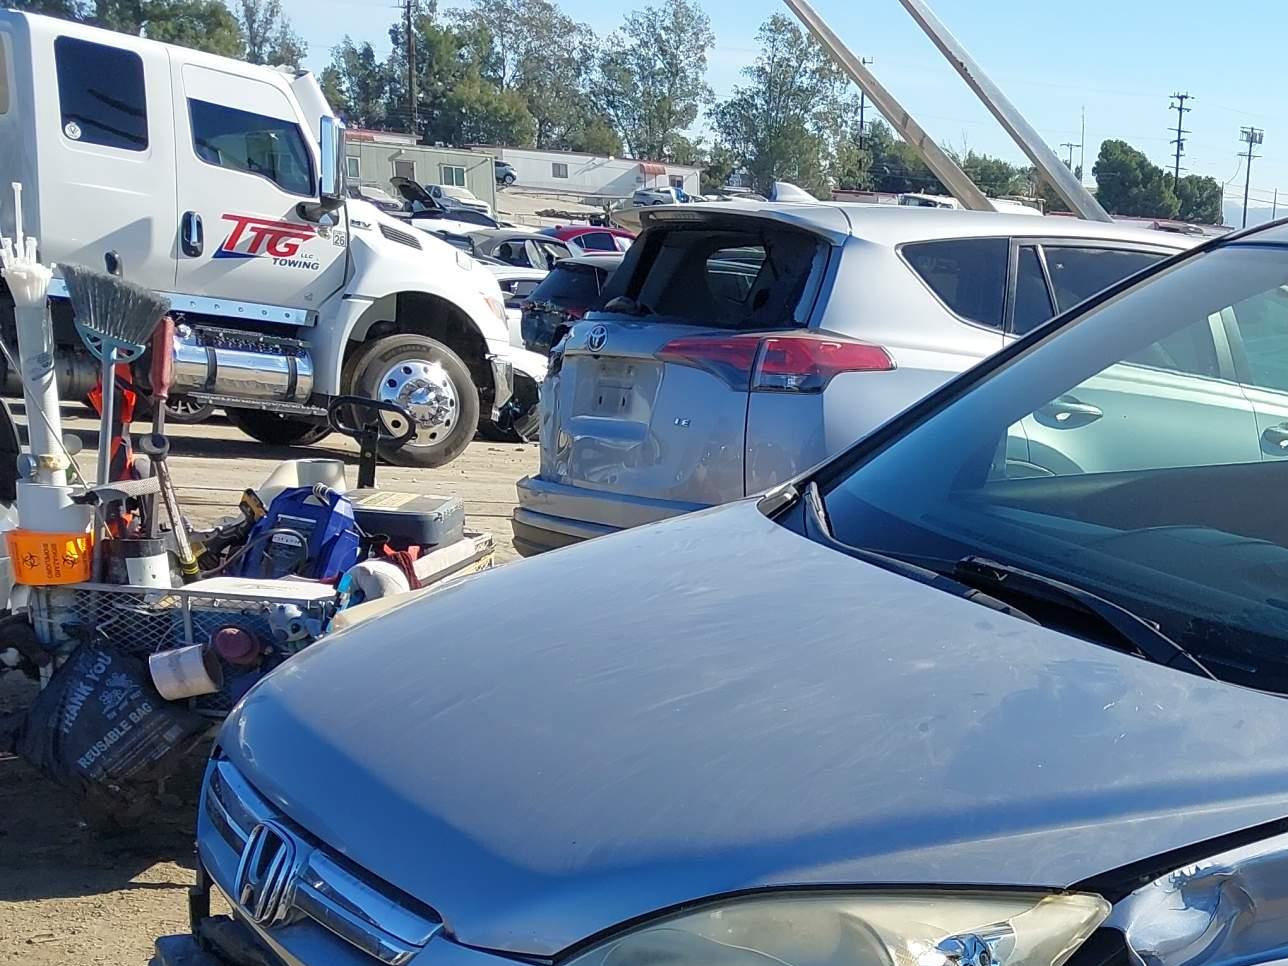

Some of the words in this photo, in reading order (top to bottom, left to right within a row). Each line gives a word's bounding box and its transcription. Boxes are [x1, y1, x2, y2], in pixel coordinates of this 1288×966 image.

[221, 213, 318, 258] TTG
[334, 235, 345, 246] 26
[272, 257, 320, 271] TOWING
[63, 682, 95, 734] THANK
[86, 652, 112, 683] YOU
[78, 719, 133, 769] REUSABLE
[128, 702, 153, 724] BAG
